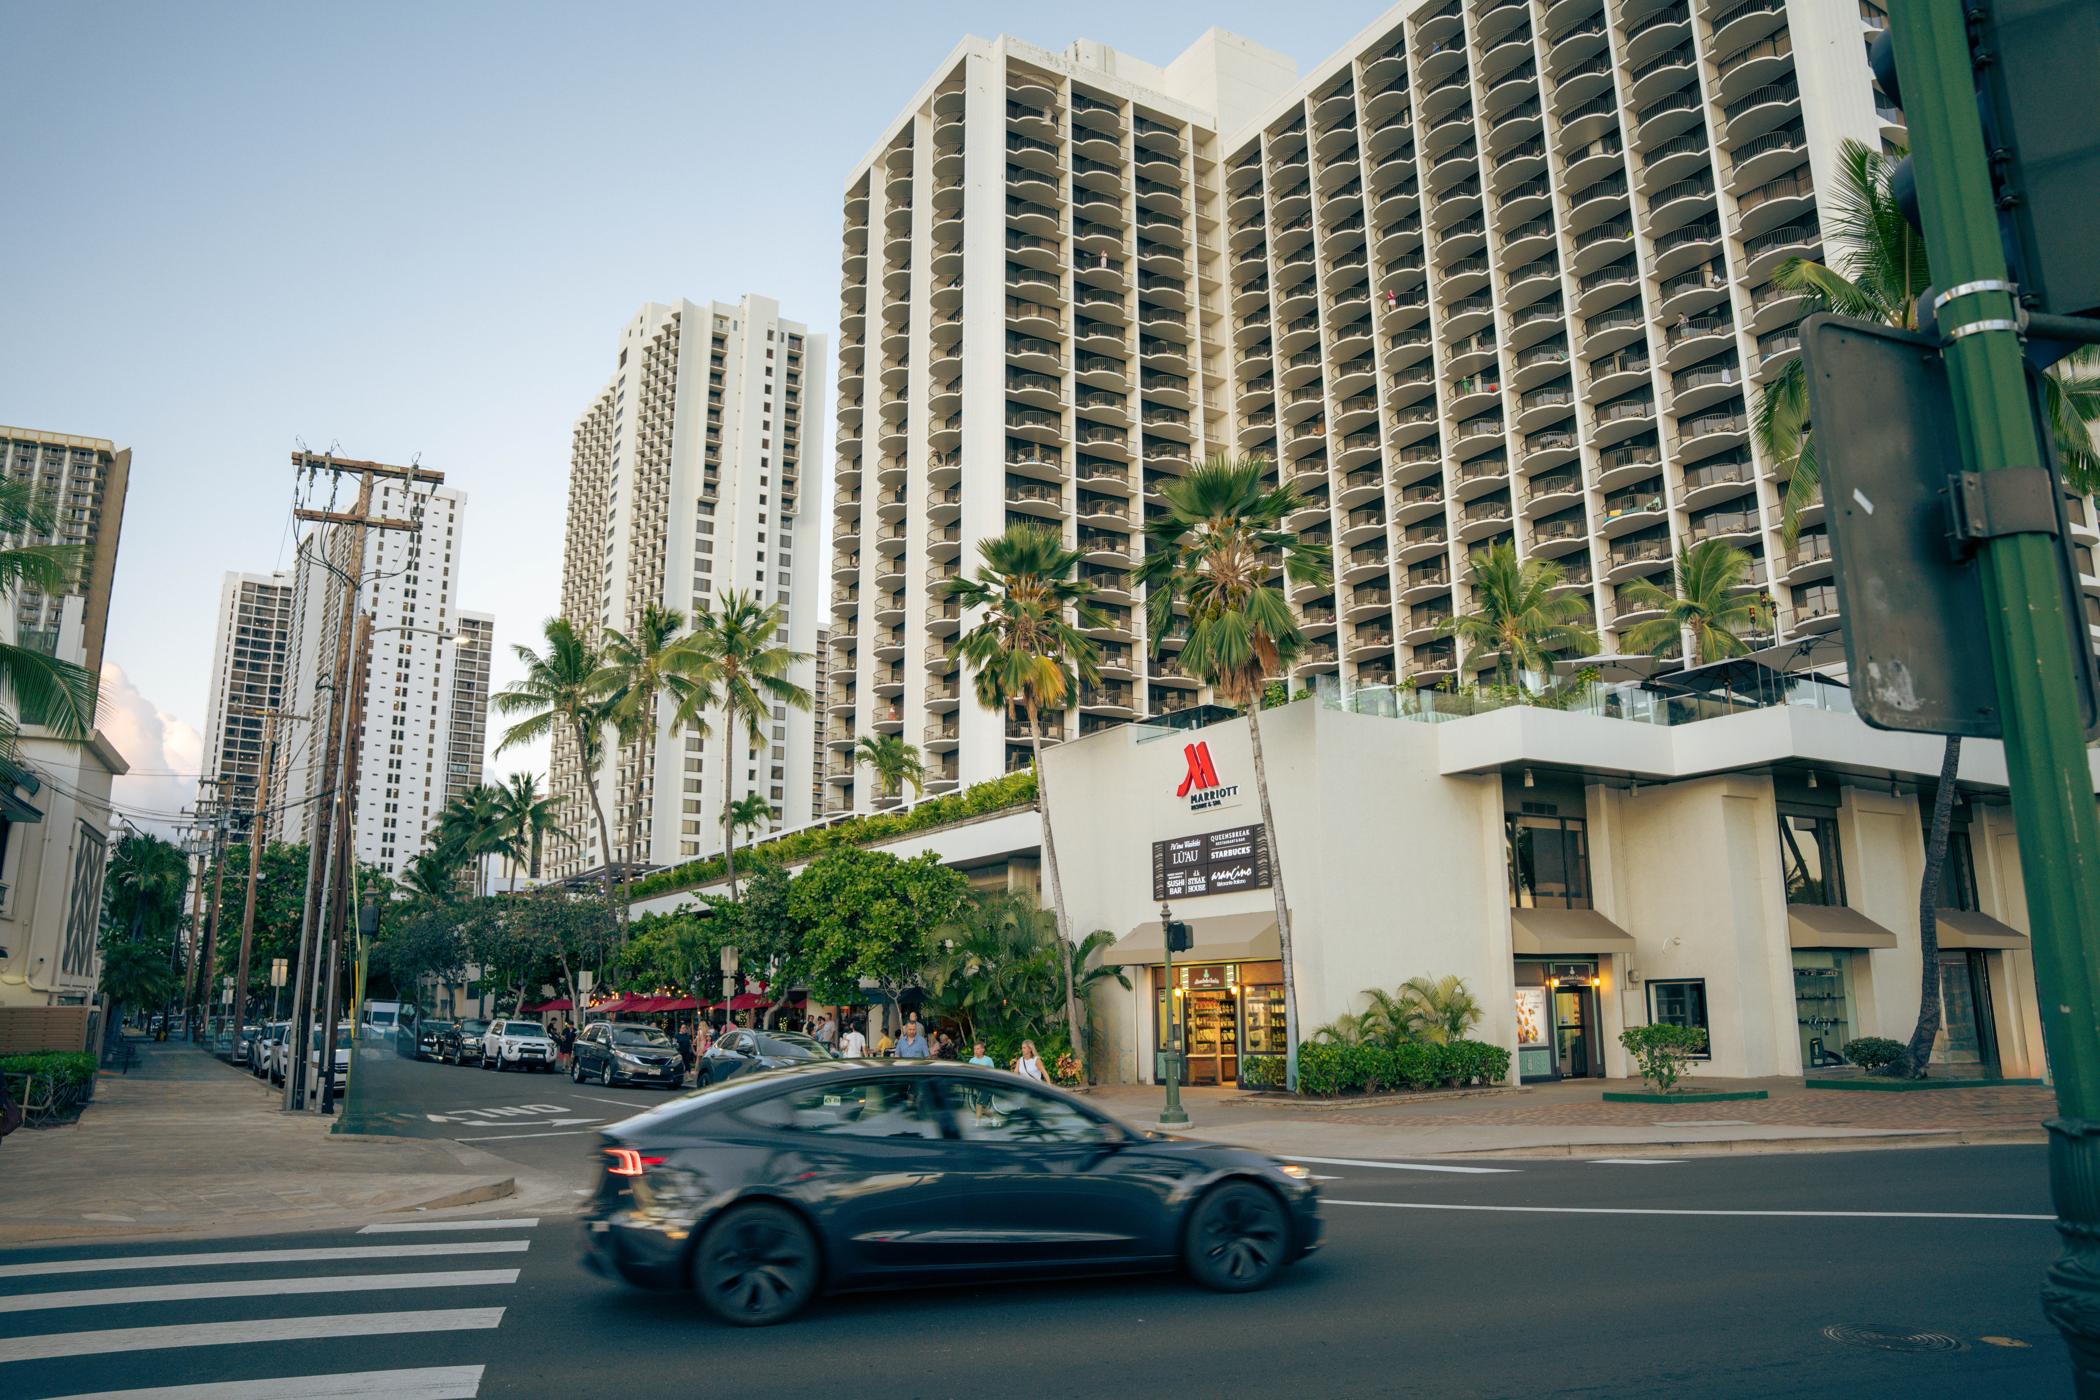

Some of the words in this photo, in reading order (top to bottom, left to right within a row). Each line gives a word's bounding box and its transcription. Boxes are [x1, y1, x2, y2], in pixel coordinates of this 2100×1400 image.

[1190, 785, 1239, 804] MARRIOTT
[1210, 829, 1250, 842] QUEENSBREAK
[1211, 846, 1251, 859] STARBUCKS
[1167, 879, 1185, 888] SUSHI
[1188, 876, 1206, 885] STEAK
[1170, 887, 1182, 895] BAR
[1188, 884, 1206, 893] HOUSE
